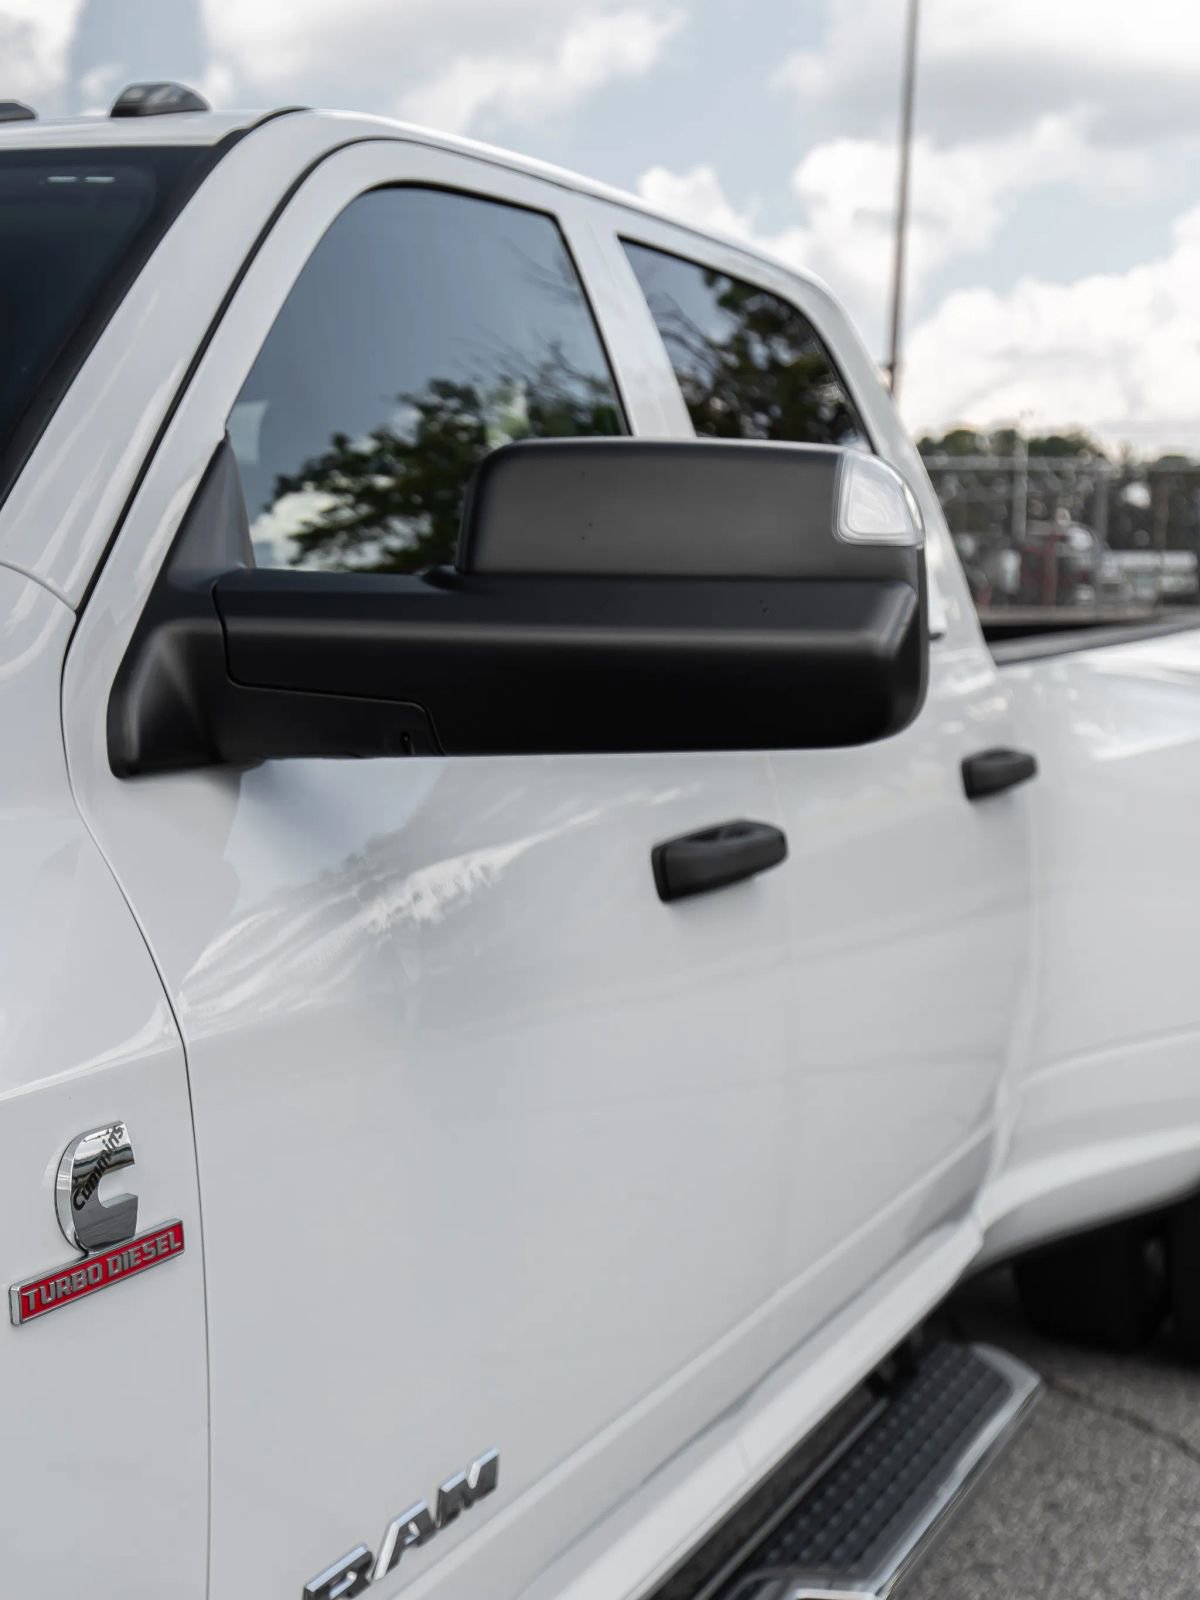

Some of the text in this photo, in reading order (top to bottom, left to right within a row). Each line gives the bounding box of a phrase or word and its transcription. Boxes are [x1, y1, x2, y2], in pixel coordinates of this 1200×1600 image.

[72, 1125, 125, 1211] Cummins
[22, 1230, 182, 1312] TURBO DIESEL
[302, 1447, 500, 1600] RAM
